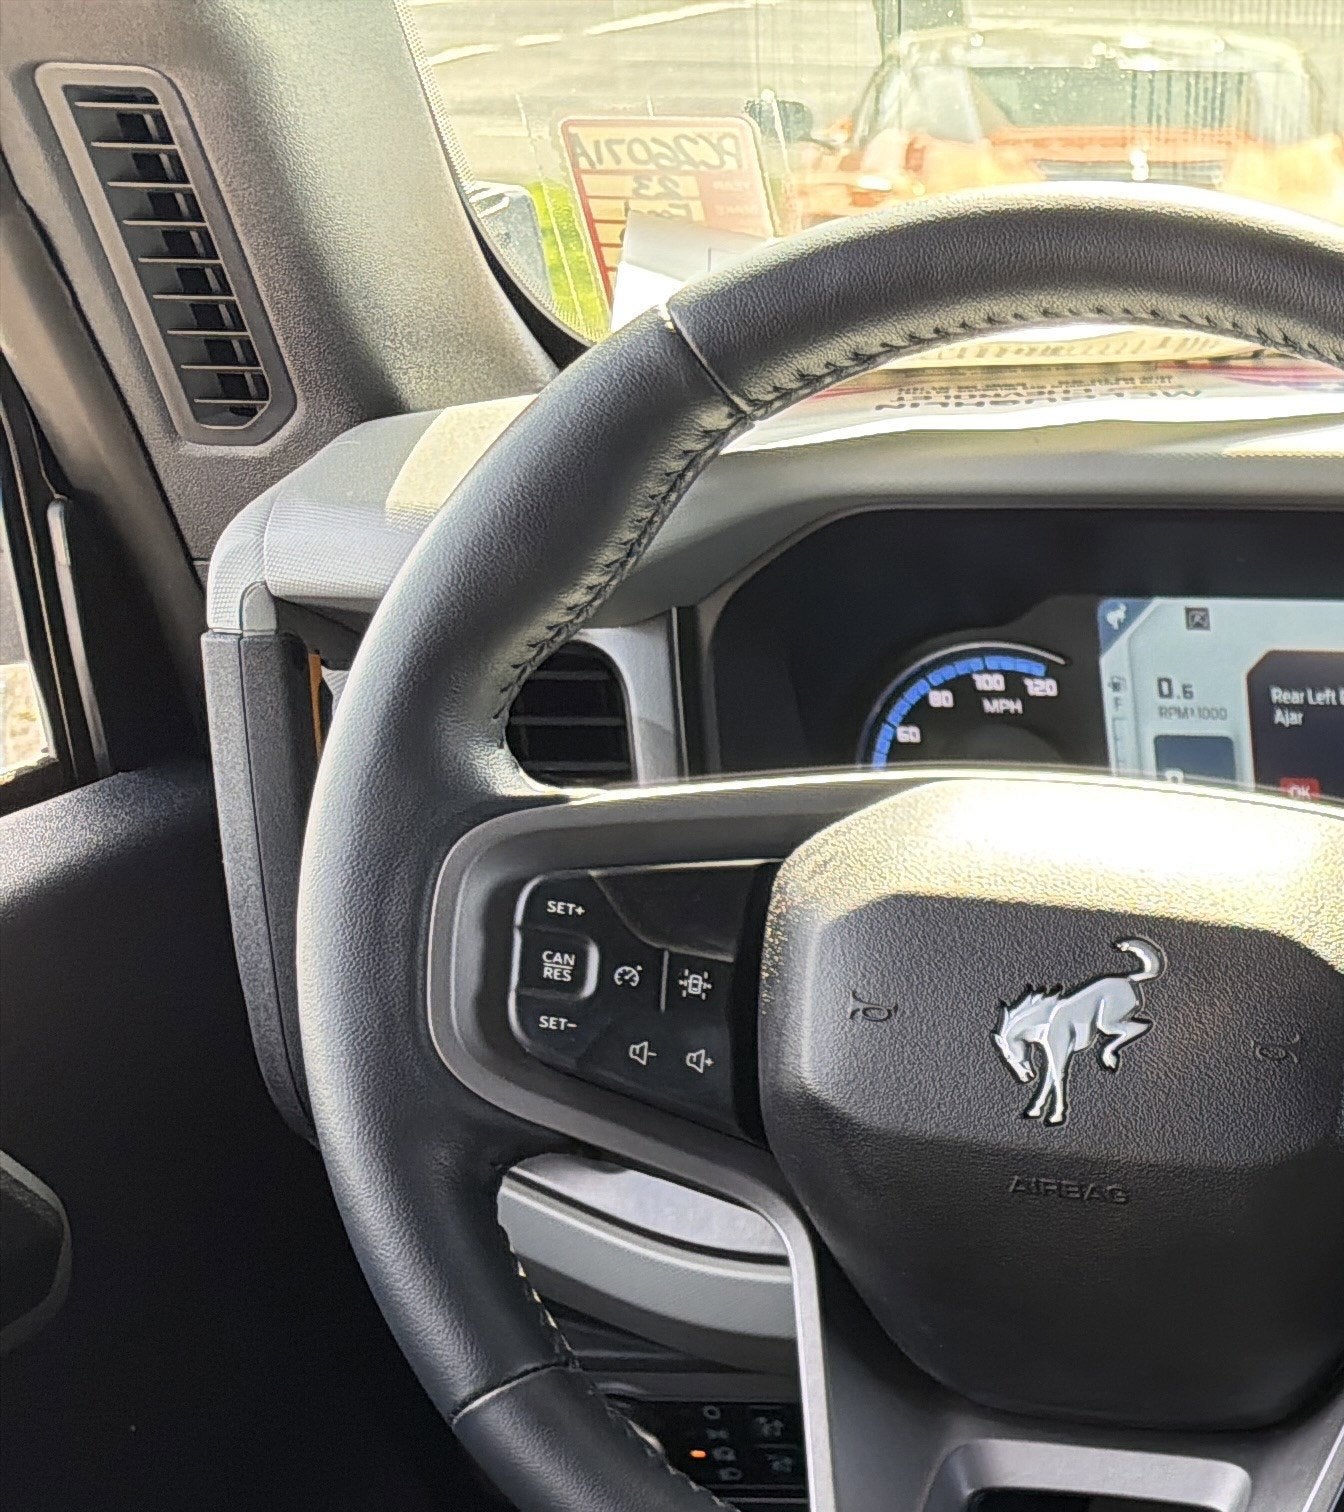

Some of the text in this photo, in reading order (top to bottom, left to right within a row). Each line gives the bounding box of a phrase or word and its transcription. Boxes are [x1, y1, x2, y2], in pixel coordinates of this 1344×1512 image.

[972, 672, 1006, 691] 100
[1023, 677, 1058, 697] 120
[928, 689, 954, 708] 80
[1270, 685, 1304, 705] Rear
[1307, 687, 1337, 706] Left
[982, 697, 1023, 714] MPH
[1274, 708, 1304, 727] Ajar
[896, 725, 921, 743] 60
[546, 901, 585, 916] SET+
[542, 951, 575, 966] CAN
[543, 967, 572, 982] RES
[1007, 1174, 1128, 1204] AIRBAG
